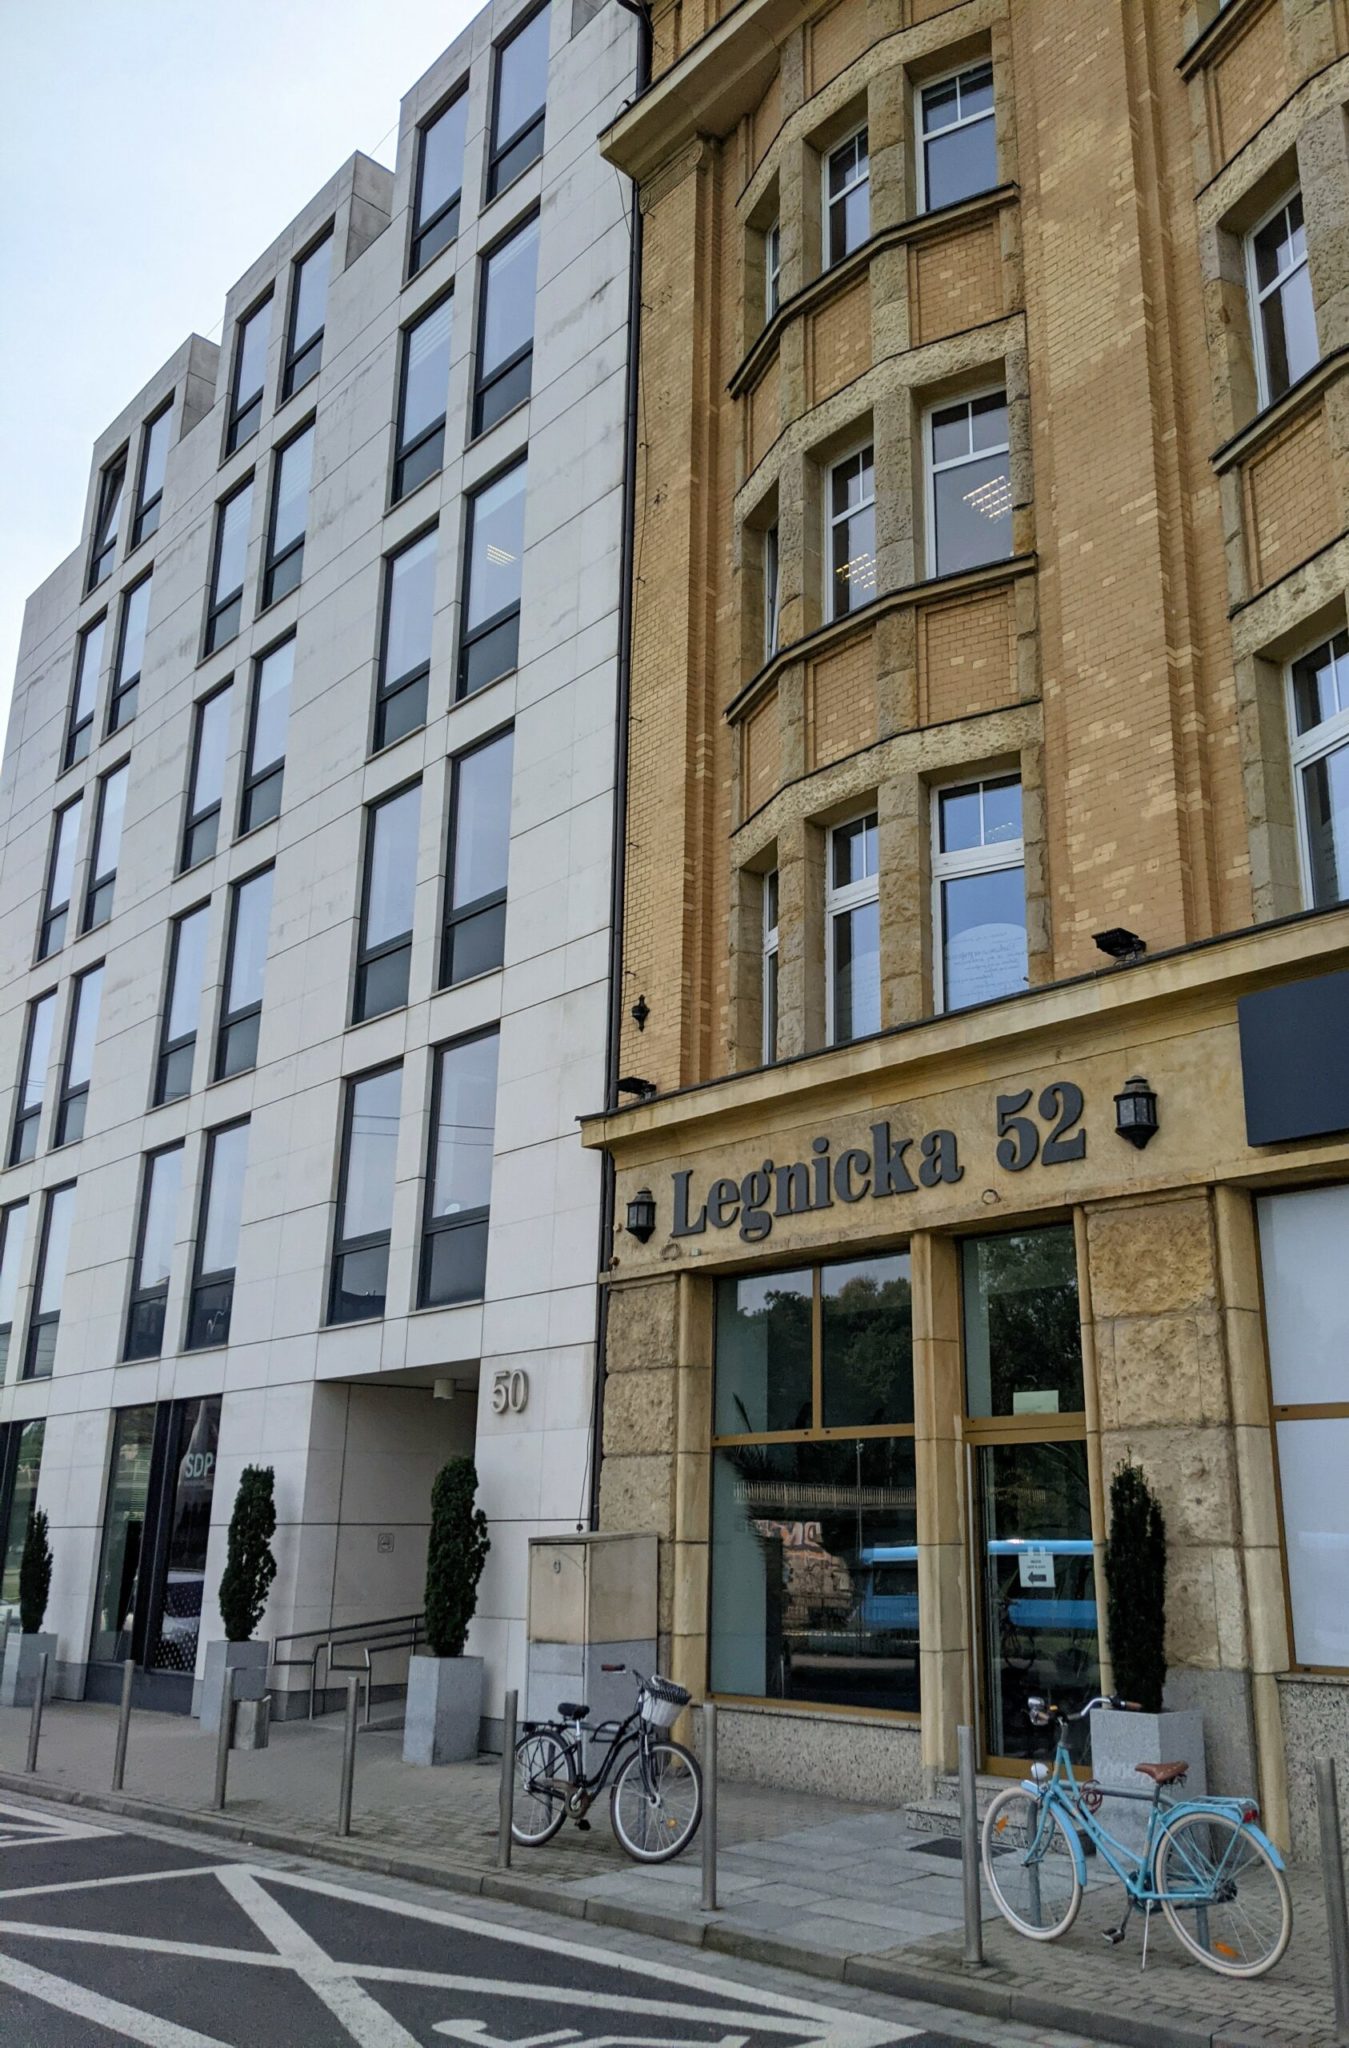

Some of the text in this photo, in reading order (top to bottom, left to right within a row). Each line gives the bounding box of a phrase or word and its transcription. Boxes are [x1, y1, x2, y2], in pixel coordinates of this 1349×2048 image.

[671, 1081, 1087, 1243] Legnicka 52
[491, 1370, 530, 1414] 50
[185, 1452, 214, 1478] SDP
